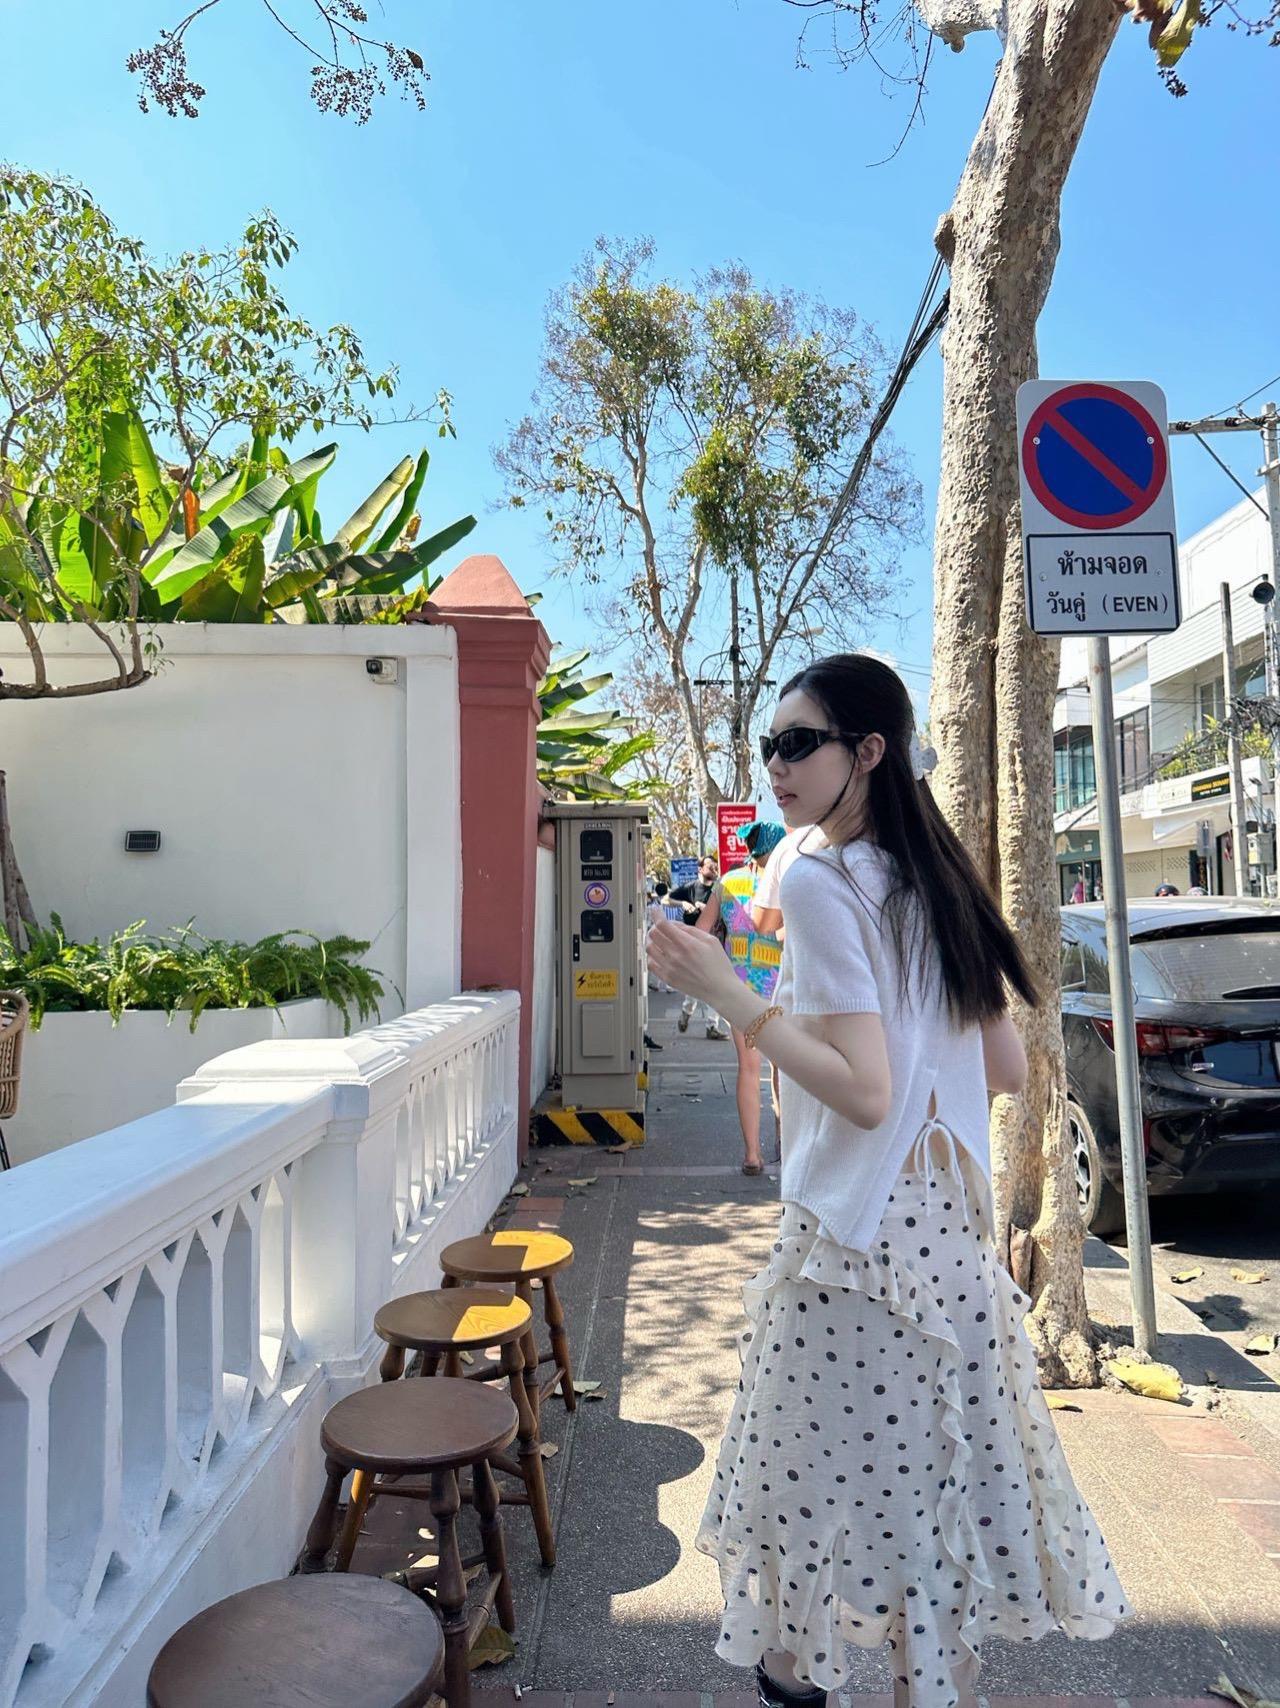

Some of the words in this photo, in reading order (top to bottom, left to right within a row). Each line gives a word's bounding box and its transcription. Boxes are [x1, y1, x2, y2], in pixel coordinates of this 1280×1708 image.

[1058, 550, 1147, 576] ห้ามจอด
[1047, 591, 1086, 622] วันคู่
[1102, 592, 1168, 616] (EVEN)
